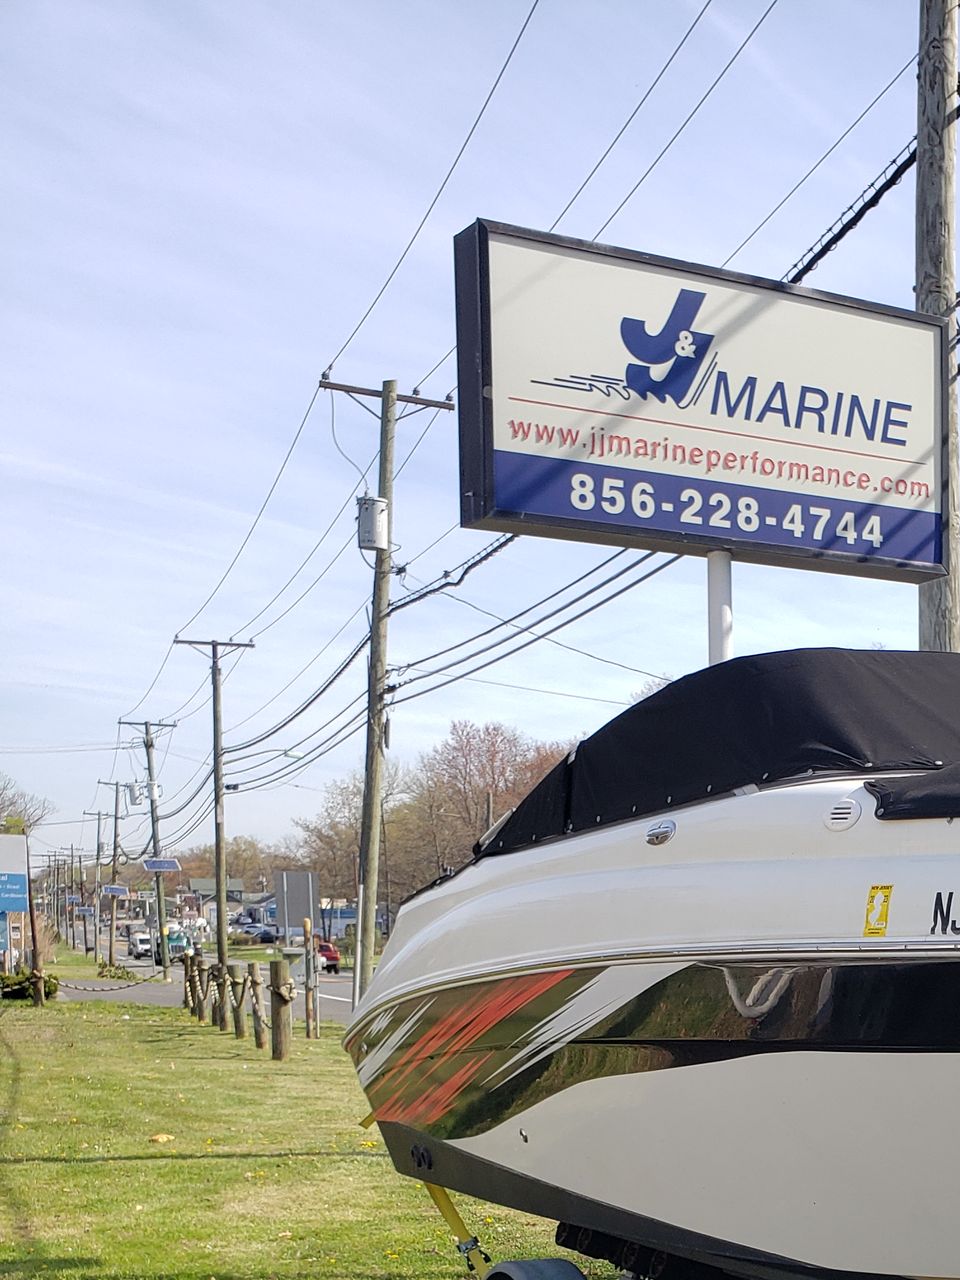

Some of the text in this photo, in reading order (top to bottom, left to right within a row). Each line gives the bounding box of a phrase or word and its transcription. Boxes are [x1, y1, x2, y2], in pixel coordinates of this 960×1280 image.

[710, 371, 912, 447] MARINE
[508, 419, 930, 498] www.jjmarineperformance.com
[570, 473, 883, 548] 856-228-4744
